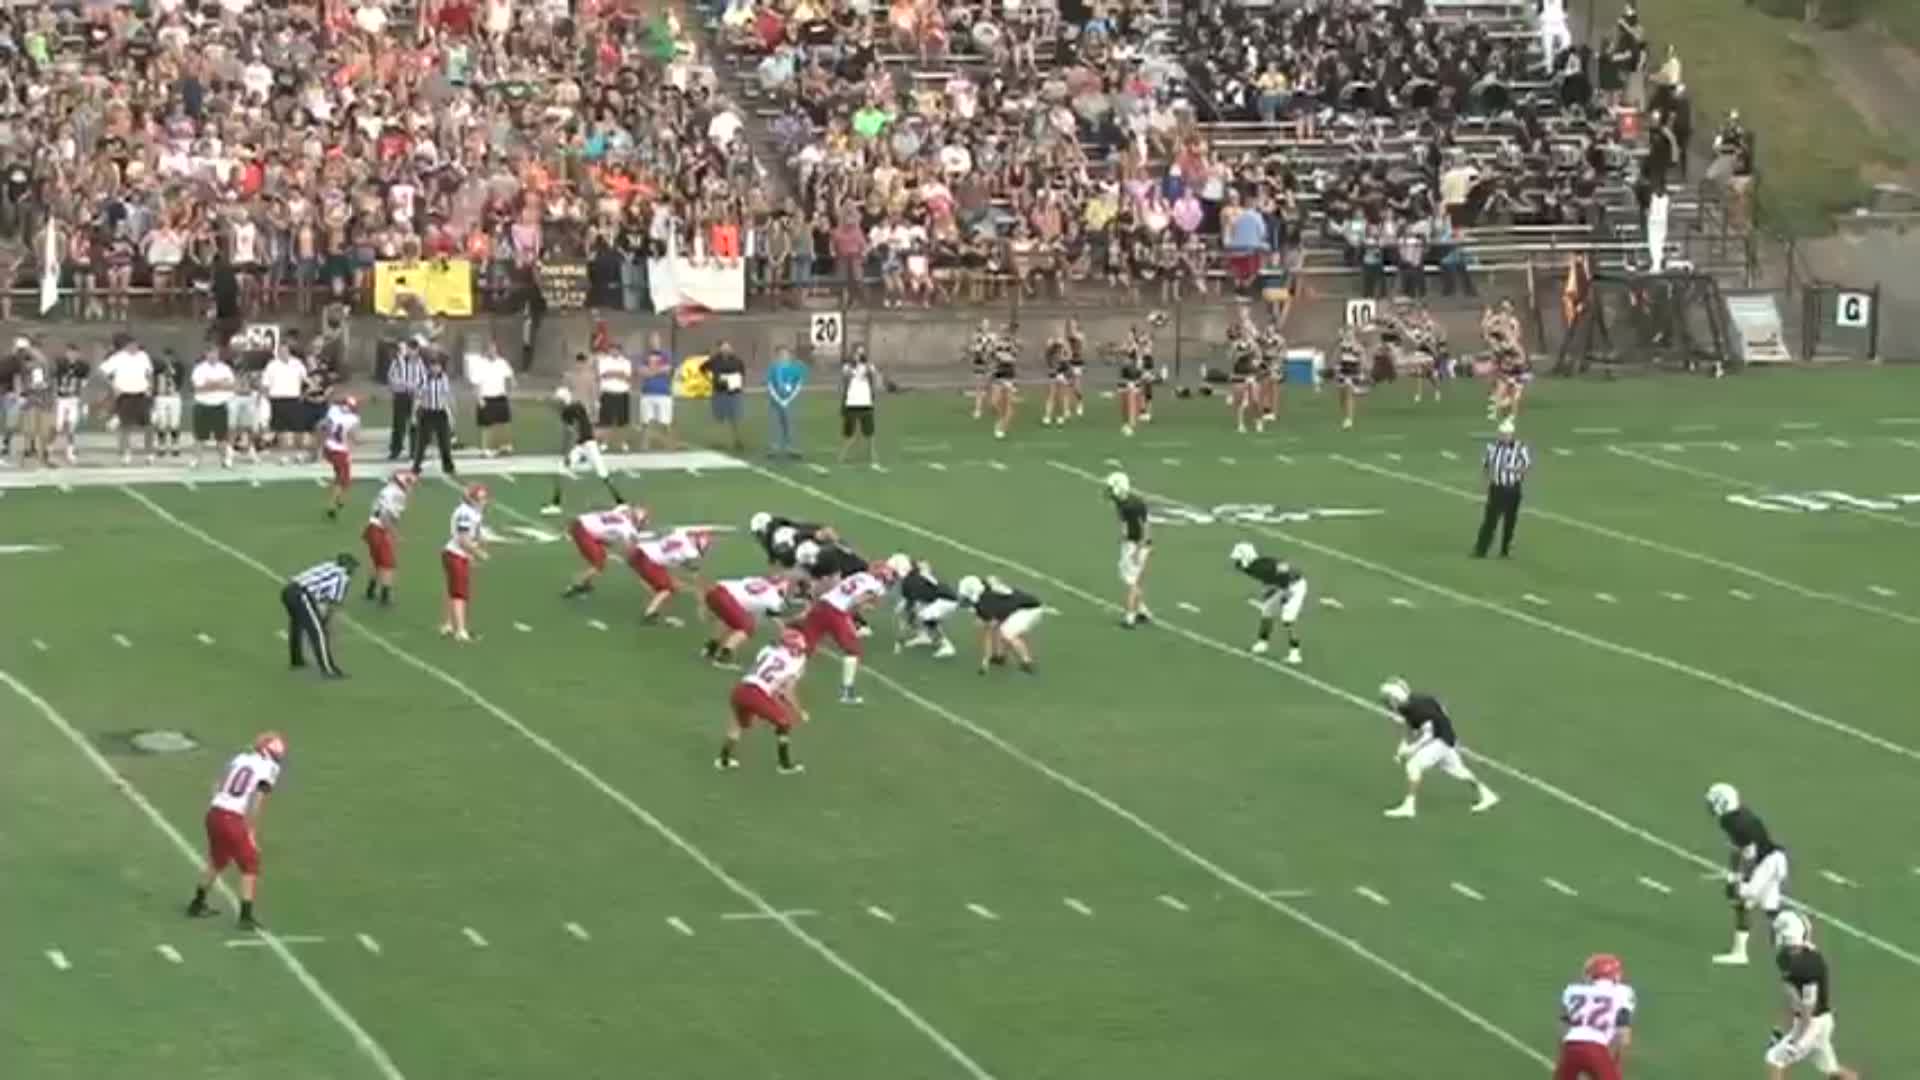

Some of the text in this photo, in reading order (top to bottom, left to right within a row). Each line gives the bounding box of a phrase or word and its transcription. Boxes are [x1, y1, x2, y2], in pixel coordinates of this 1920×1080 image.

[1352, 304, 1371, 322] 10
[1845, 297, 1860, 321] G
[815, 317, 838, 342] 20
[1567, 994, 1613, 1031] 22
